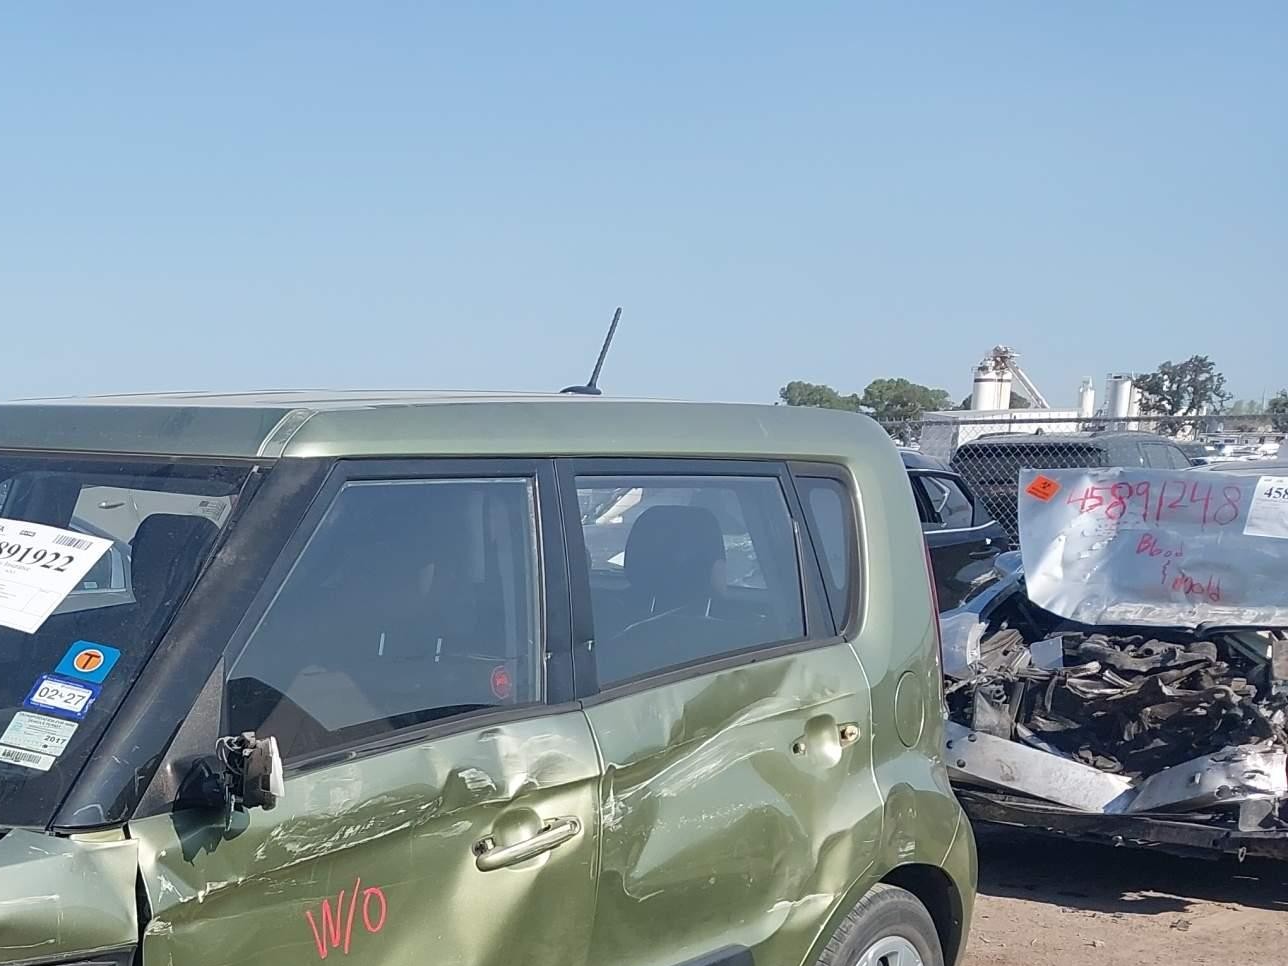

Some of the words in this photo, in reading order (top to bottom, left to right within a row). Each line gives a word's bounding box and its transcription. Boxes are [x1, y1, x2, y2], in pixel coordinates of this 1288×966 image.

[1066, 480, 1242, 529] 45891248
[82, 652, 102, 670] T
[43, 735, 67, 745] 2017
[305, 876, 387, 959] W/O
